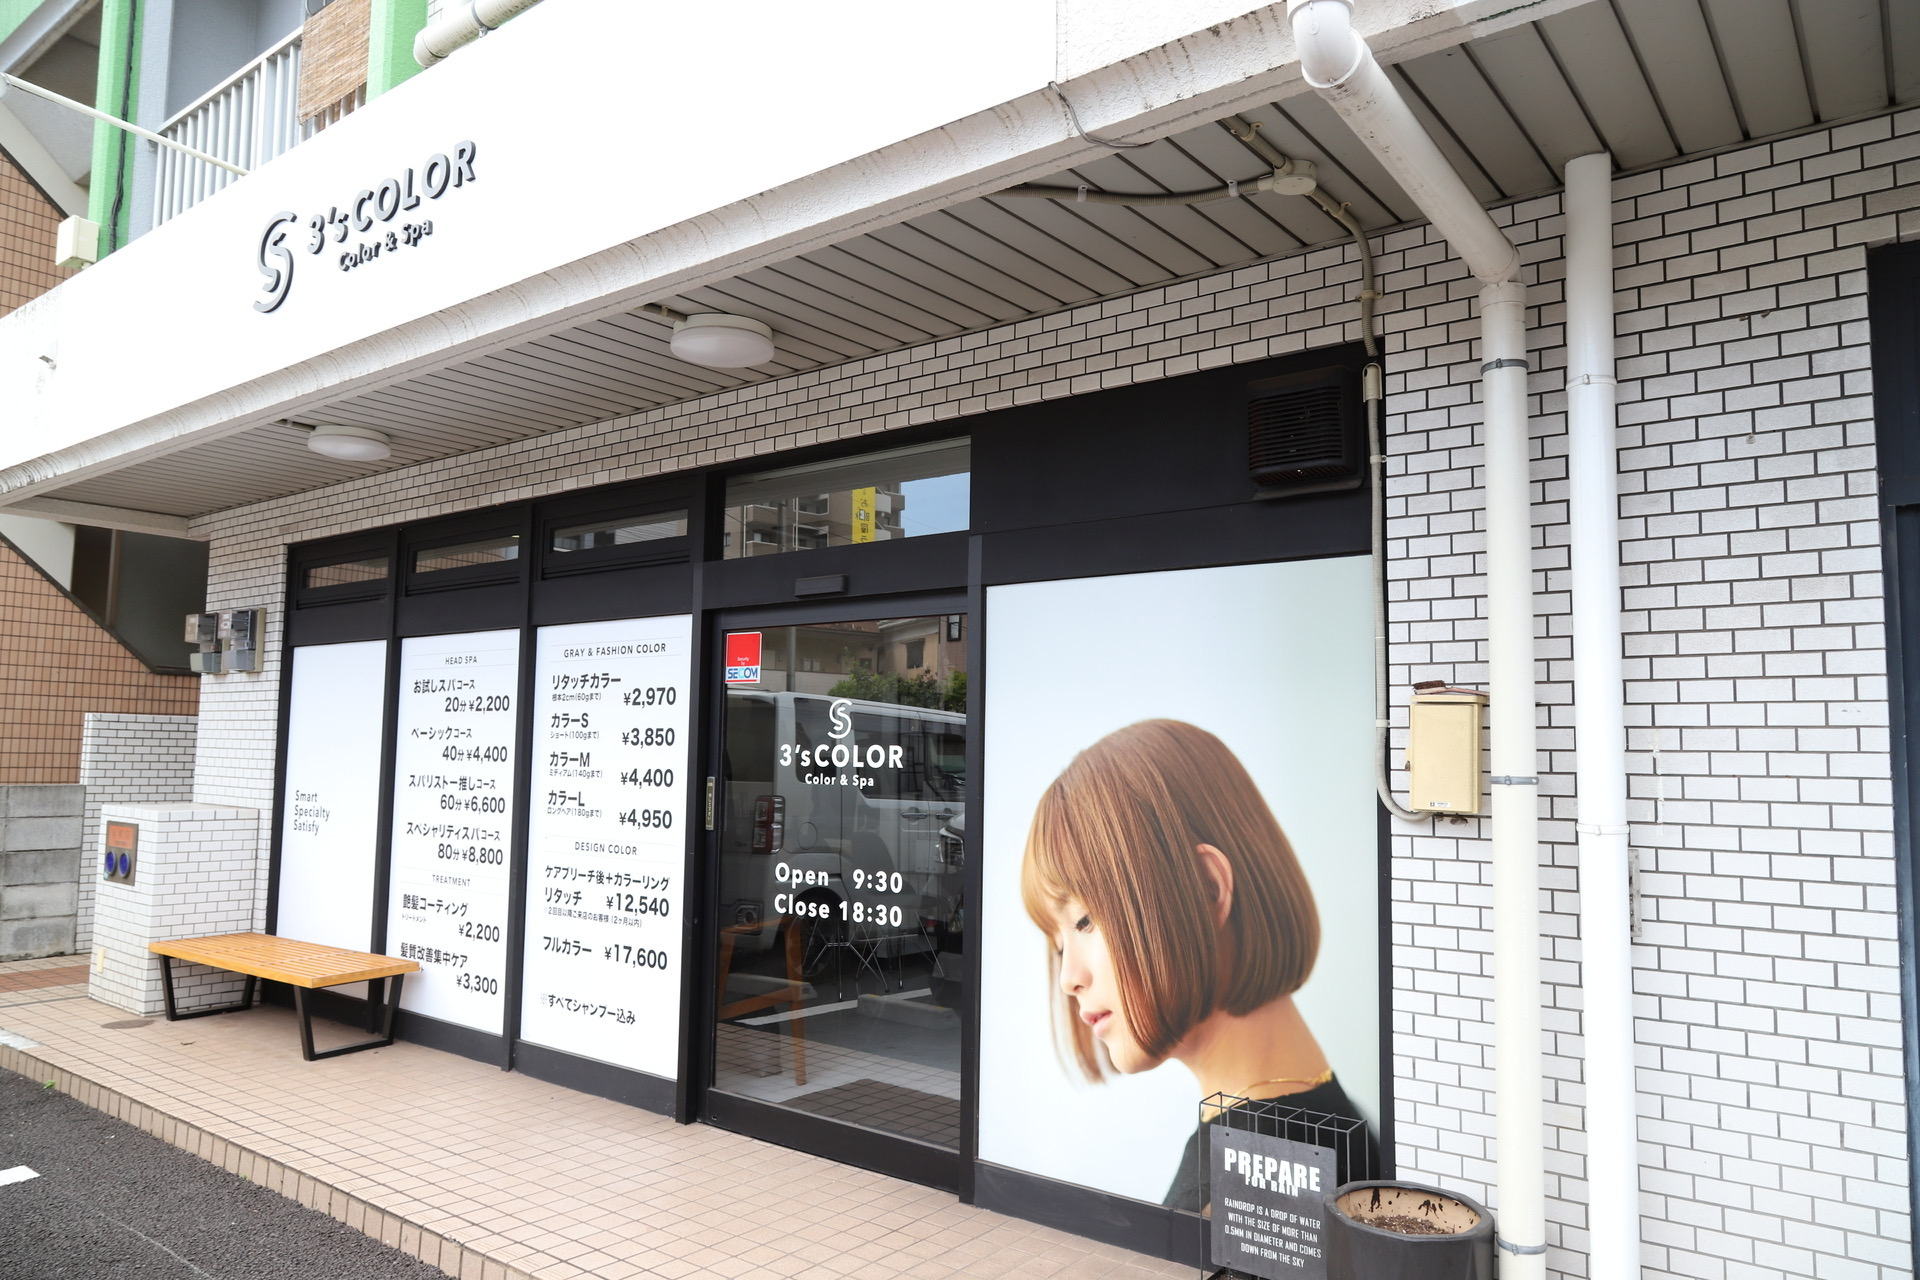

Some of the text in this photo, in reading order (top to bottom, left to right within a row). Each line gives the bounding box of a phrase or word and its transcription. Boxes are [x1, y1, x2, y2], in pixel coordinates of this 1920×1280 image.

[338, 220, 433, 271] Color & Spa
[564, 643, 666, 658] GRAY & FASHION COLOR
[552, 672, 621, 690] リタッチカラー
[728, 668, 757, 679] SECOM
[469, 695, 509, 714] ¥2,200
[623, 687, 676, 709] ¥2,970
[551, 713, 589, 729] カラーS
[412, 726, 472, 740] ベーシックコース
[622, 727, 675, 749] ¥3,850
[467, 746, 507, 764] ¥4,400
[550, 751, 590, 768] カラーM
[621, 768, 673, 789] ¥4,400
[805, 773, 874, 789] Color & Spa
[295, 790, 318, 802] Smart
[465, 796, 505, 814] ¥6,600
[548, 790, 585, 807] カラーL
[294, 805, 330, 821] Specialty
[619, 809, 672, 830] ¥4,950
[294, 819, 319, 836] Satisfy
[462, 846, 503, 865] ¥8,800
[575, 842, 637, 856] DESIGN COLOR
[432, 875, 471, 887] TREATMENT
[775, 862, 903, 894] Open 9:30
[545, 887, 669, 917] リタッチ ¥12,540
[774, 894, 902, 927] Close 18:30
[459, 922, 499, 942] ¥2,200
[400, 942, 468, 969] 髪質改善集中ケア
[543, 936, 667, 970] フルカラー ¥17,600
[456, 973, 498, 995] ¥3,300
[1225, 1148, 1320, 1192] PREPARE
[1245, 1172, 1298, 1197] FOR RAIN
[1225, 1198, 1255, 1212] RAINDROP
[1257, 1206, 1263, 1215] IS
[1271, 1209, 1287, 1221] DROP
[1290, 1214, 1297, 1223] OF
[1300, 1216, 1320, 1229] WATER
[1228, 1212, 1317, 1242] WITH THE SIZE OF MORE THAN
[1225, 1225, 1321, 1258] 0.5MM IN DIAMETER AND COMES
[1241, 1243, 1304, 1267] DOWN FROM THE SKY
